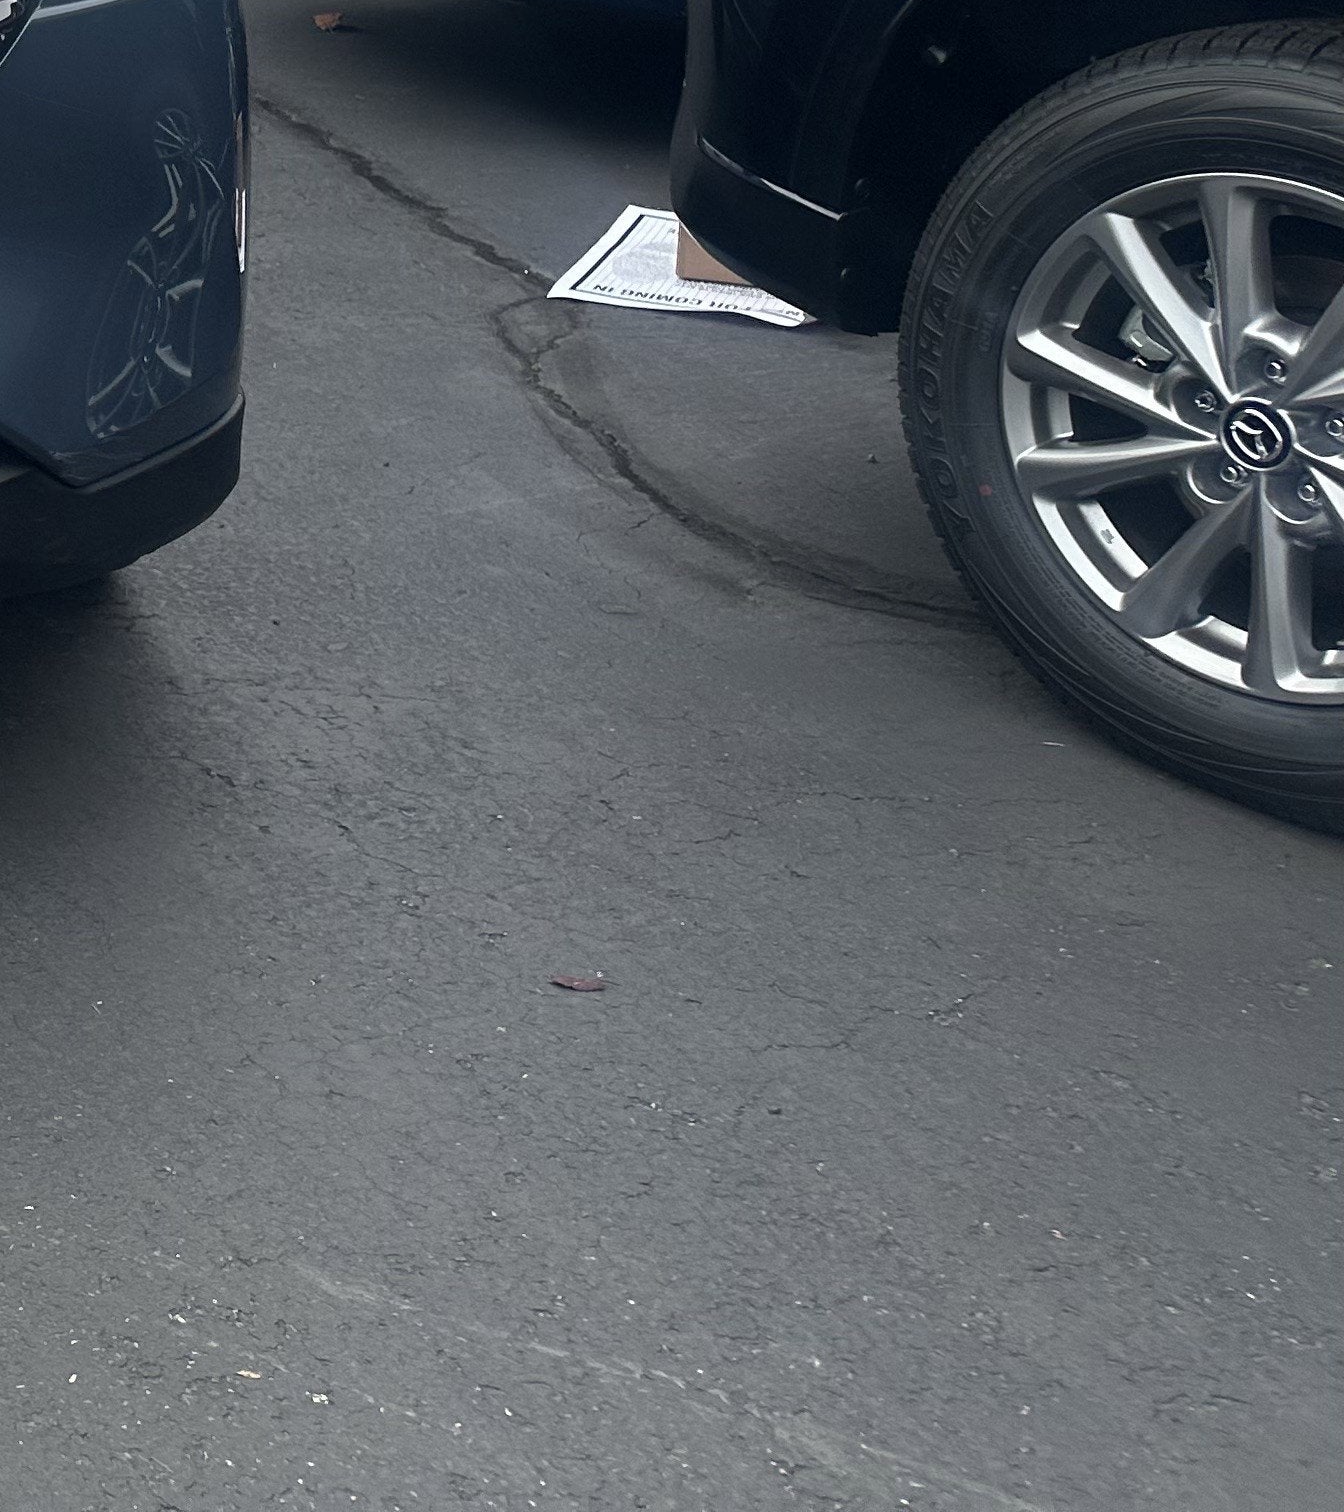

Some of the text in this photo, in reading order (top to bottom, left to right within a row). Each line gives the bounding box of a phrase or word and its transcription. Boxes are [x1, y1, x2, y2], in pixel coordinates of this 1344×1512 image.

[593, 284, 615, 293] IN
[620, 288, 703, 306] COMING
[915, 199, 995, 534] YOKOHAMA
